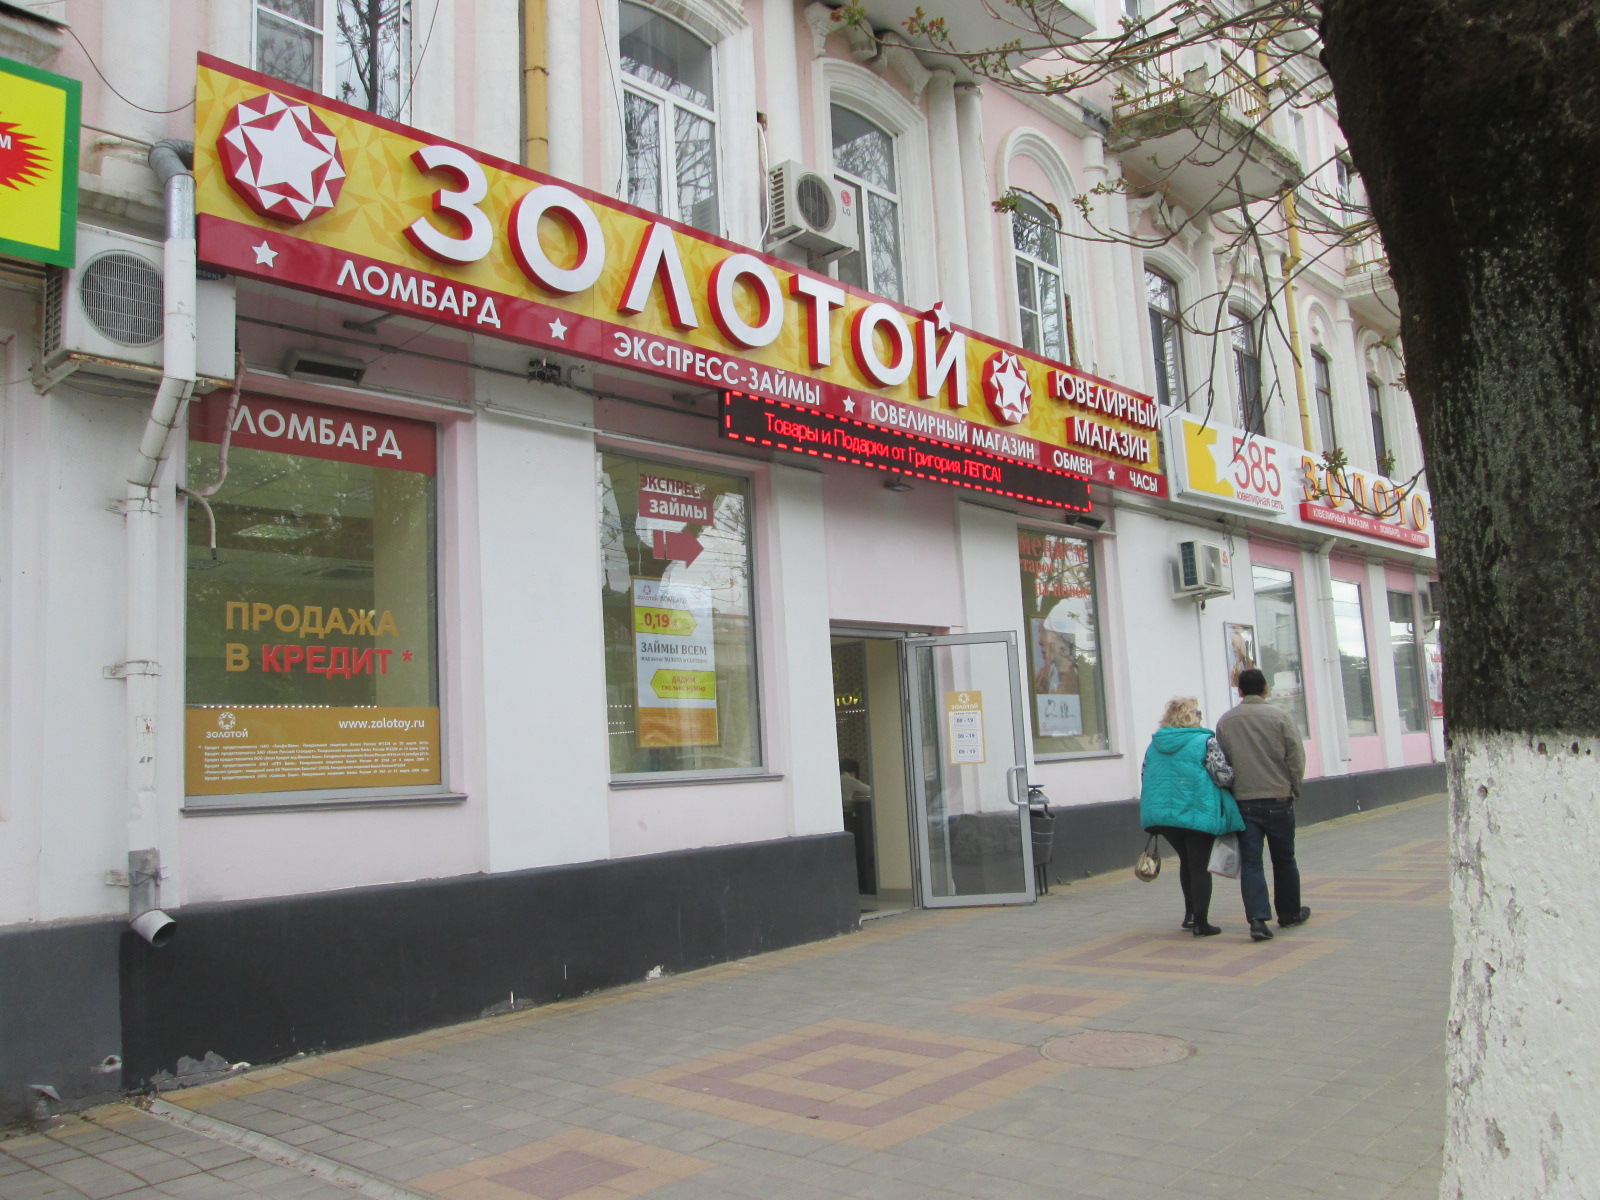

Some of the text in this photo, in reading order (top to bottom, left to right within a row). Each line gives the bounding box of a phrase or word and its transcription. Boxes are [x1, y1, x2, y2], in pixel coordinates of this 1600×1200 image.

[402, 145, 968, 407] ЗОЛОТОЙ
[336, 259, 1158, 493] ЛОМБАРД ЭКСПРЕСС-ЗАЙМЫ ЮВЕЛИРНЫЙ МАГАЗИН ОБМЕН ЧАСЫ
[1055, 370, 1161, 431] ЮВЕЛИРНЫЙ
[231, 404, 402, 460] ЛОМБАРД
[764, 411, 819, 443] Товары
[821, 431, 831, 445] и
[833, 428, 890, 457] Подарки
[892, 446, 906, 461] от
[908, 446, 961, 474] Григория
[1073, 416, 1151, 464] МАГАЗИН
[1232, 436, 1281, 497] 585
[649, 497, 708, 520] займы
[1301, 455, 1427, 530] ЗОЛОТО
[1312, 507, 1347, 525] ЮВЕЛИРНЫЙ
[1347, 516, 1369, 529] МАГАЗИН
[225, 601, 399, 639] ПРОДАЖА
[644, 612, 670, 630] 0,19
[225, 643, 393, 680] В КРЕДИТ
[641, 640, 707, 656] ЗАЙМЫ ВСЕМ
[205, 728, 249, 739] ЗОЛОТОЙ
[338, 717, 425, 732] www.zolotoy.ru
